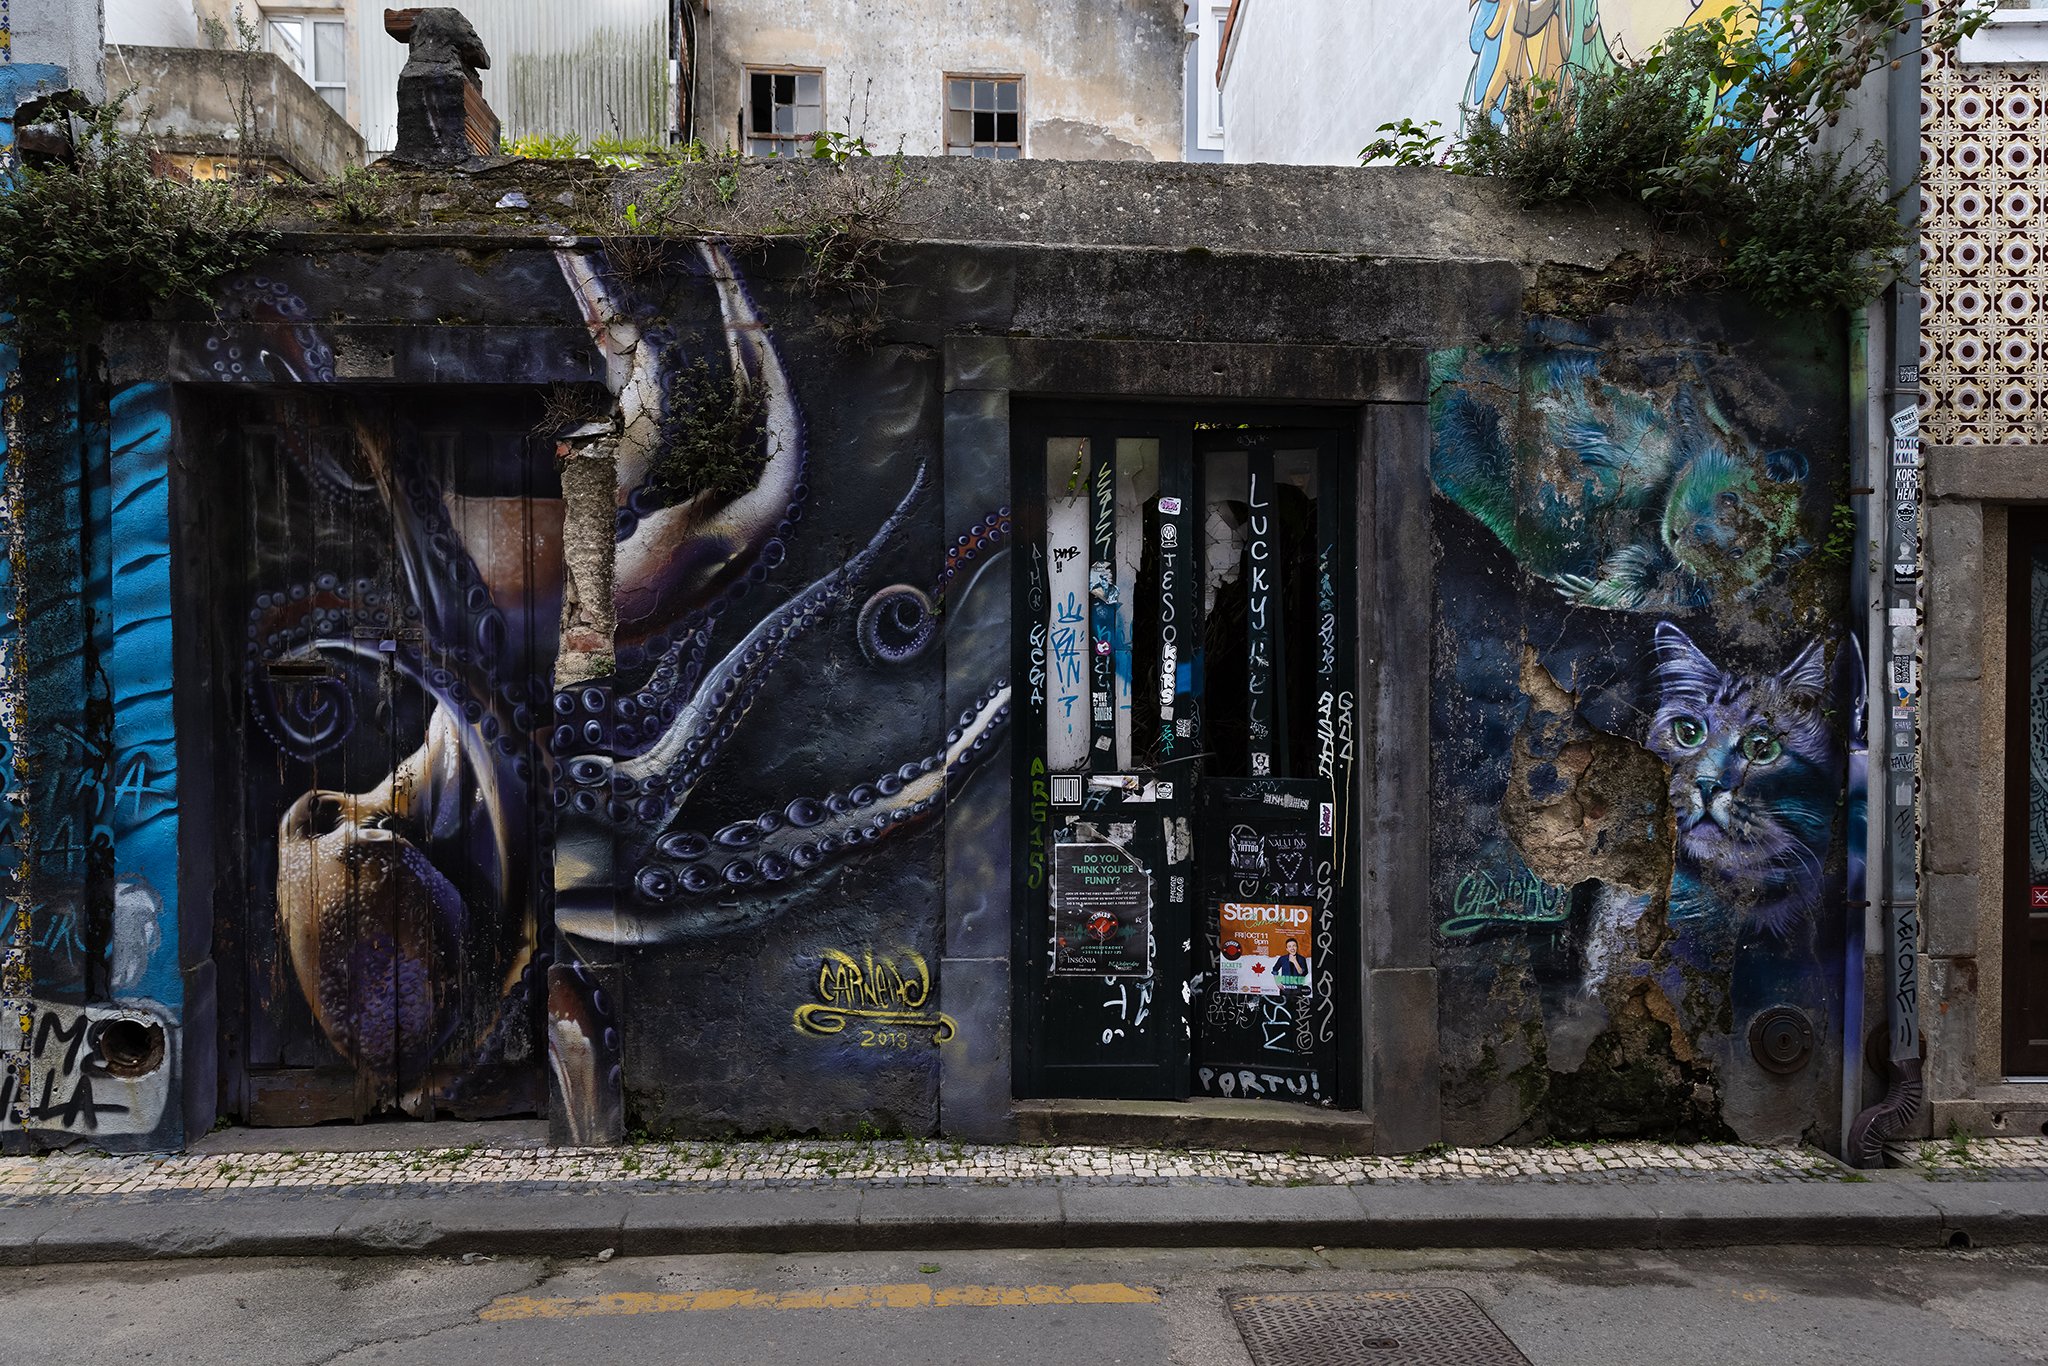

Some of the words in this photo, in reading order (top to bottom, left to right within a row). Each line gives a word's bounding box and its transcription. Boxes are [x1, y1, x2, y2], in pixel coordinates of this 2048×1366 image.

[1894, 411, 1915, 424] STREET
[1895, 439, 1919, 450] TOXIC
[1895, 468, 1917, 481] KORS
[1896, 488, 1915, 500] HEM
[1250, 473, 1269, 630] LUCKY
[1160, 642, 1177, 705] KORS
[1084, 855, 1098, 863] DO
[1100, 855, 1119, 863] YOU
[1072, 866, 1099, 874] THINK
[1101, 866, 1134, 874] YOU'RE
[1085, 877, 1121, 885] FUNNY?
[1067, 956, 1097, 964] INSÓNIA
